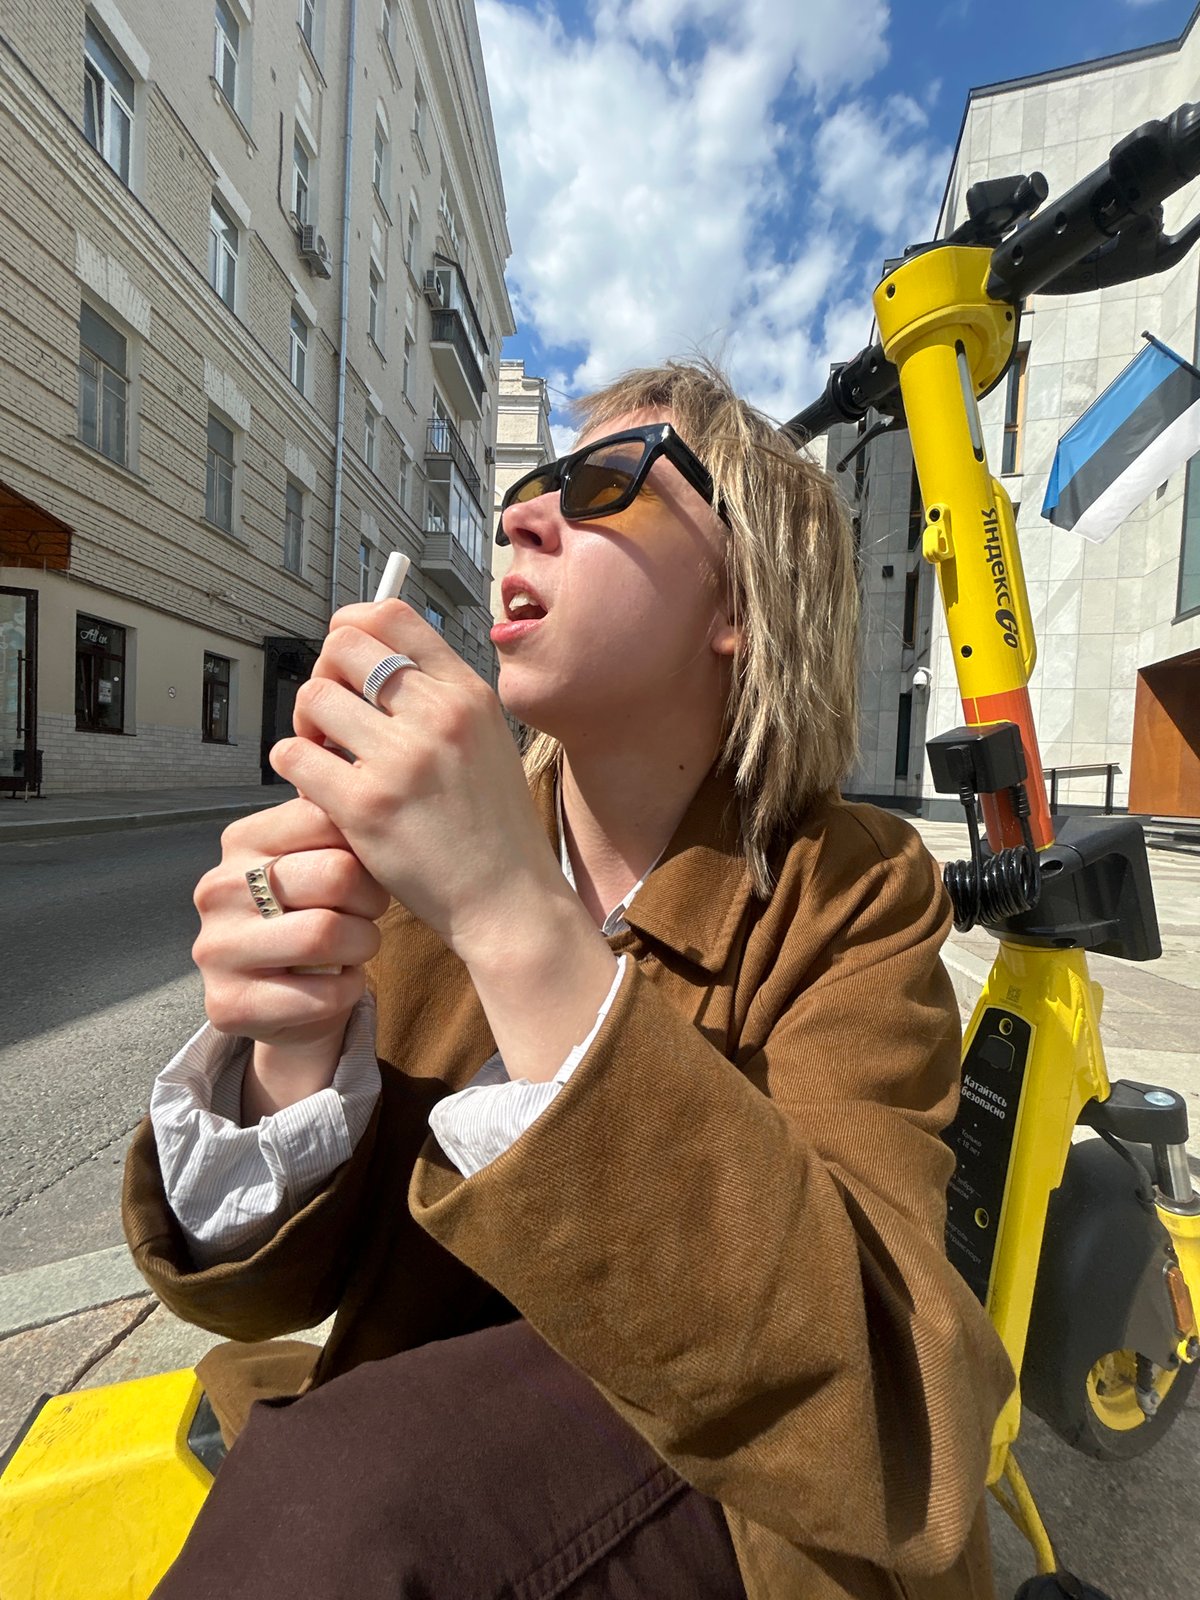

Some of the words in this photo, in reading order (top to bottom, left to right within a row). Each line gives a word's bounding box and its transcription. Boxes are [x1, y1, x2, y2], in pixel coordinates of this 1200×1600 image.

[981, 507, 1011, 607] Яндекс
[995, 608, 1019, 649] Go
[961, 1085, 1006, 1120] безопасно
[964, 1074, 1008, 1108] Катайтесь
